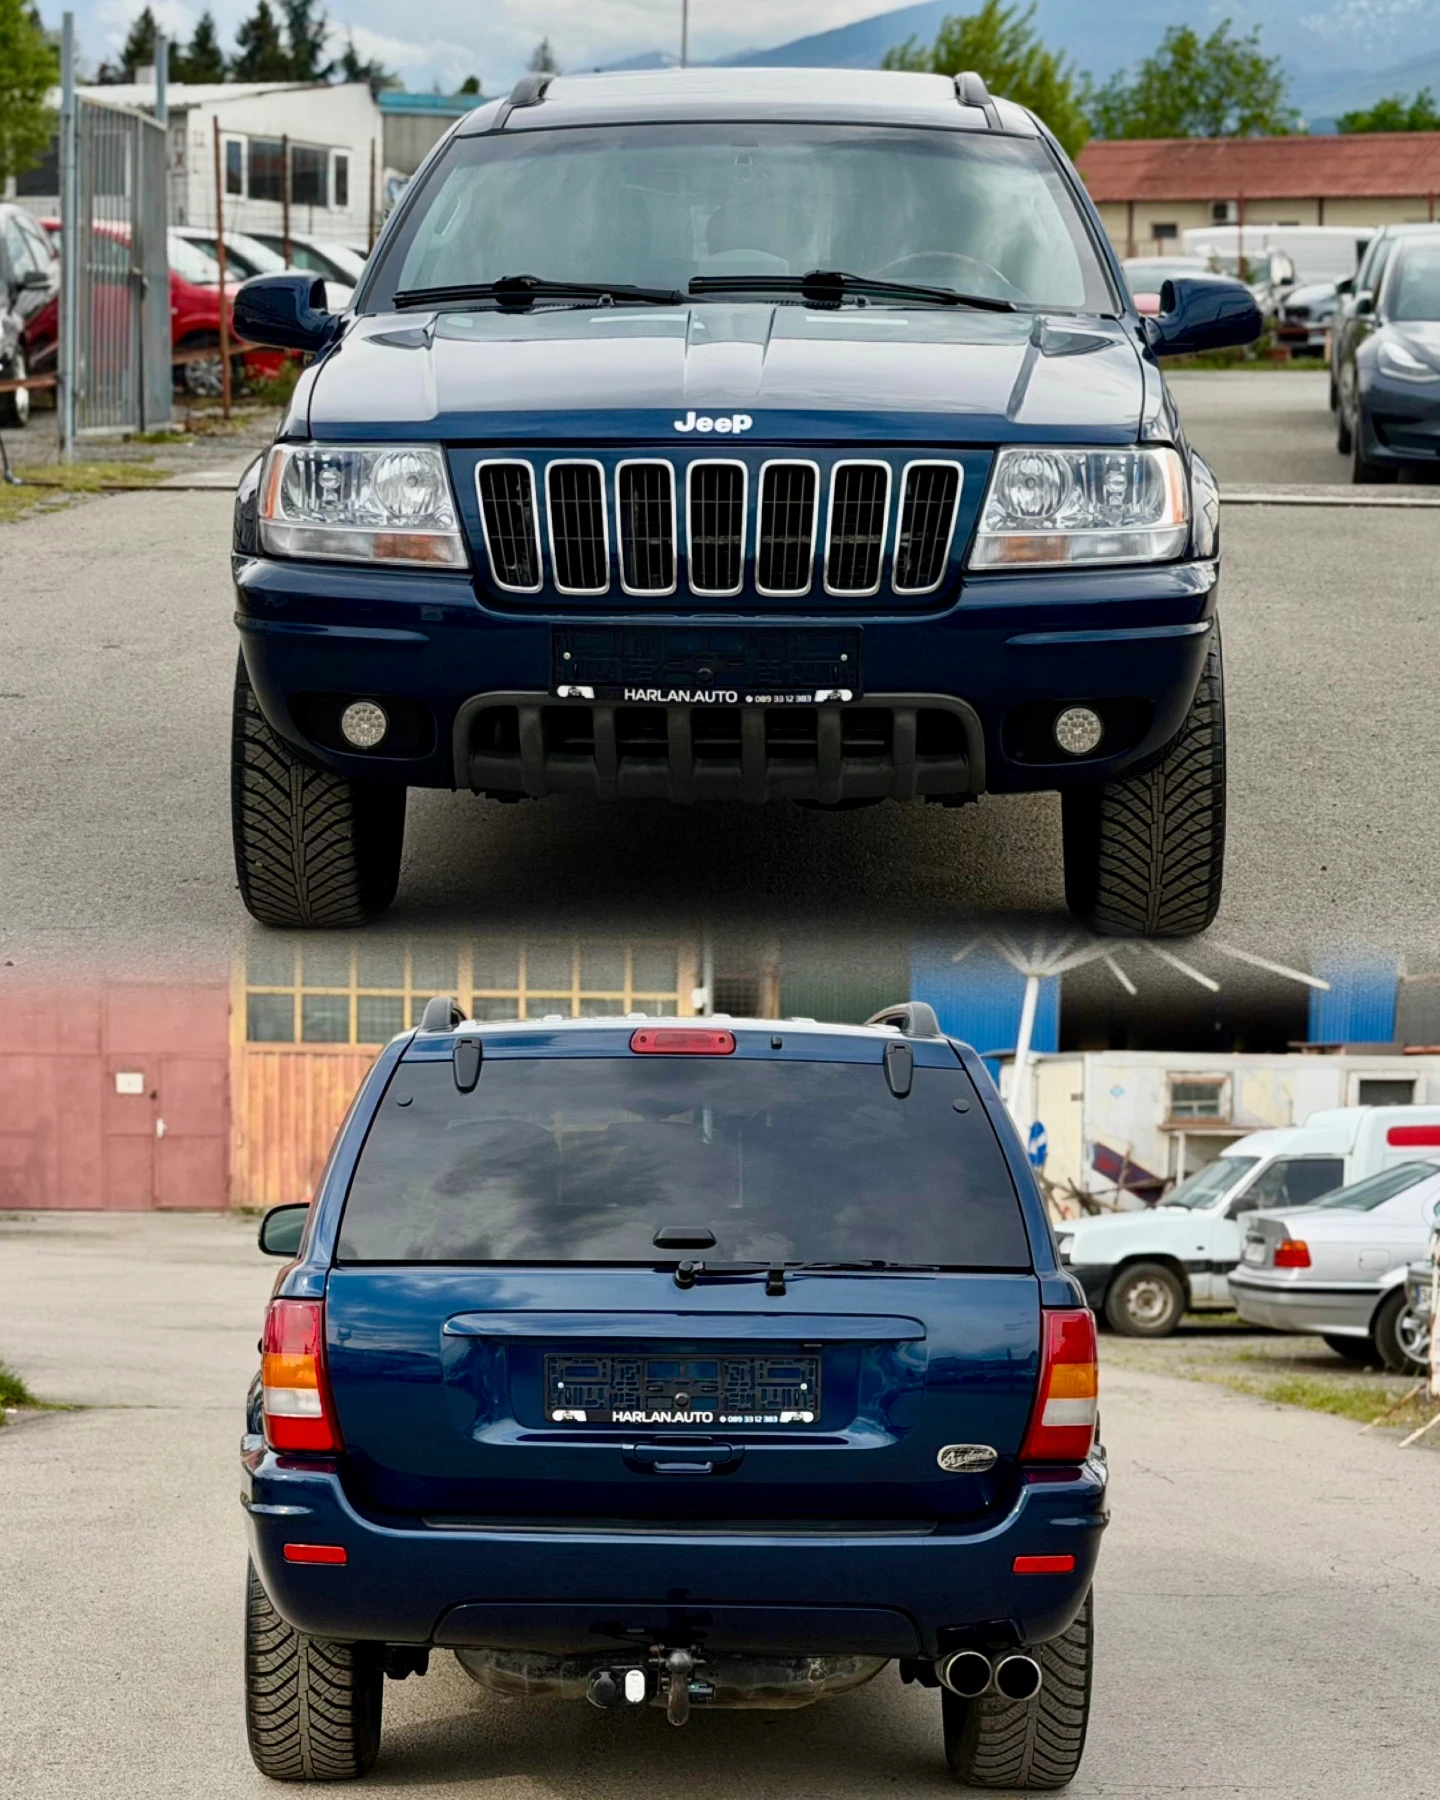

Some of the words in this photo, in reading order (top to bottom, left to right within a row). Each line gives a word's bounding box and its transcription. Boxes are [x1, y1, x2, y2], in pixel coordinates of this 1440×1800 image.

[673, 411, 753, 434] Jeep
[624, 688, 738, 703] HARLAN.AUTO
[612, 1411, 714, 1423] HARLAN.AUTO
